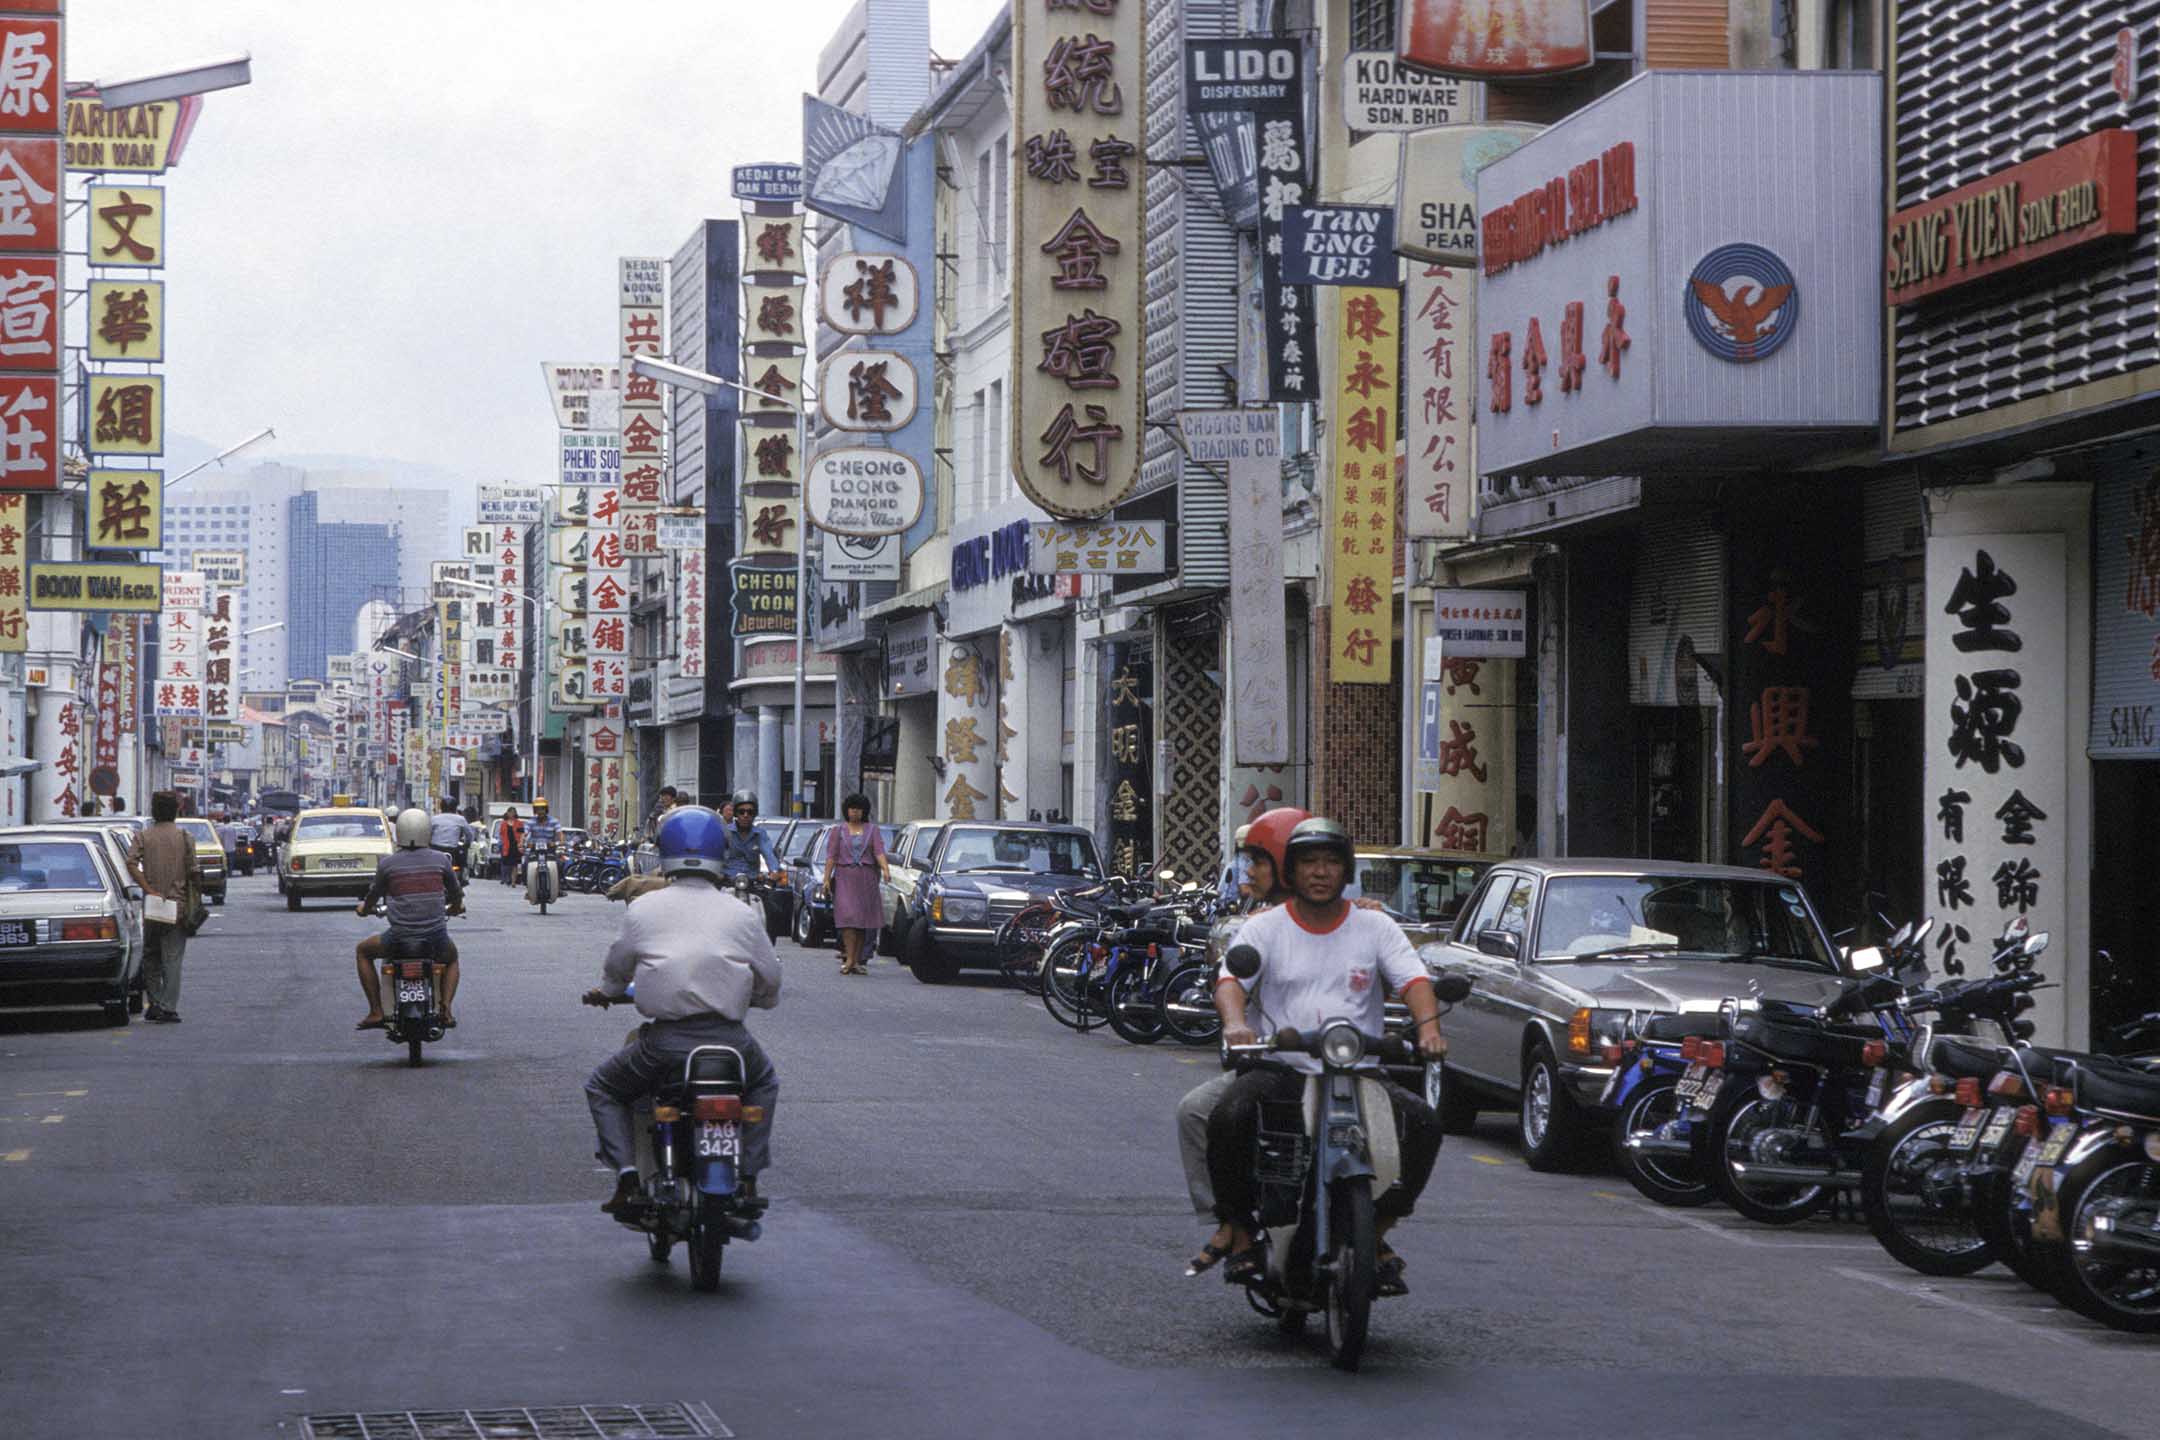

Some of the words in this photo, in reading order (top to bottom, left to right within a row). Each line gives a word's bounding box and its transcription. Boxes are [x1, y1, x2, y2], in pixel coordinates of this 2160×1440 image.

[1195, 50, 1295, 81] LIDO
[1201, 84, 1287, 99] DISPENSARY
[1359, 90, 1457, 106] HARDWARE
[1367, 109, 1409, 124] SDN.
[1412, 108, 1449, 123] BHD
[112, 143, 155, 166] WAH
[1303, 208, 1381, 232] TAN
[1303, 232, 1377, 255] ENG
[1887, 208, 1948, 289] SANG
[1953, 182, 2018, 268] YUEN
[2020, 194, 2057, 244] SDN.
[2057, 181, 2097, 233] BHD.
[1308, 256, 1372, 281] LEE
[1344, 294, 1391, 454] 陳永利
[563, 449, 597, 470] PHENG
[1190, 438, 1250, 460] TRADING
[824, 460, 907, 476] CHEONG
[829, 479, 902, 494] LOONG
[830, 499, 898, 511] DIAMOND
[36, 575, 83, 599] BOON
[87, 575, 122, 599] WAH
[738, 573, 800, 591] CHEON
[751, 594, 796, 611] YOON
[699, 1139, 740, 1156] 3421
